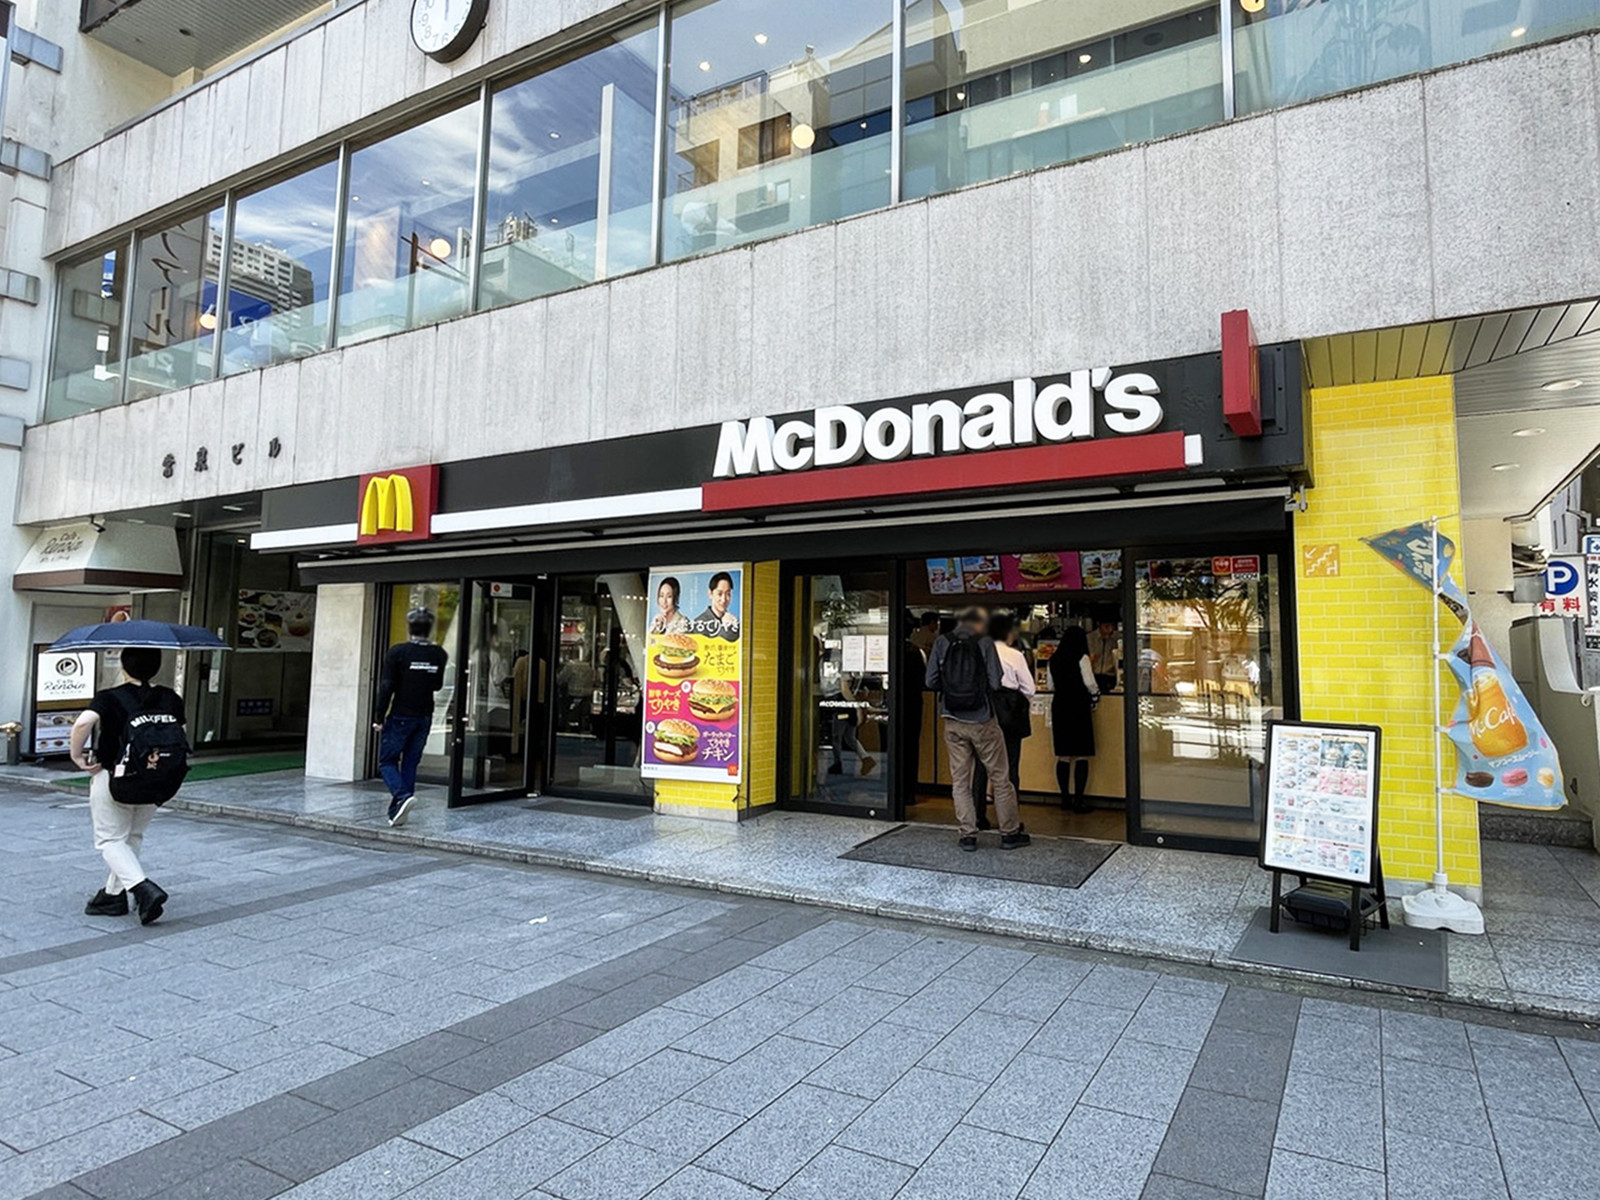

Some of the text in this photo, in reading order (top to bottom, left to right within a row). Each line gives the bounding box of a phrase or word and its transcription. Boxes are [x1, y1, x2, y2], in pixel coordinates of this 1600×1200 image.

[424, 25, 432, 39] 8
[712, 366, 1163, 479] McDonald's
[1547, 565, 1573, 592] P
[1540, 597, 1581, 612] 有料
[703, 651, 737, 666] たまご
[702, 748, 735, 761] チキン
